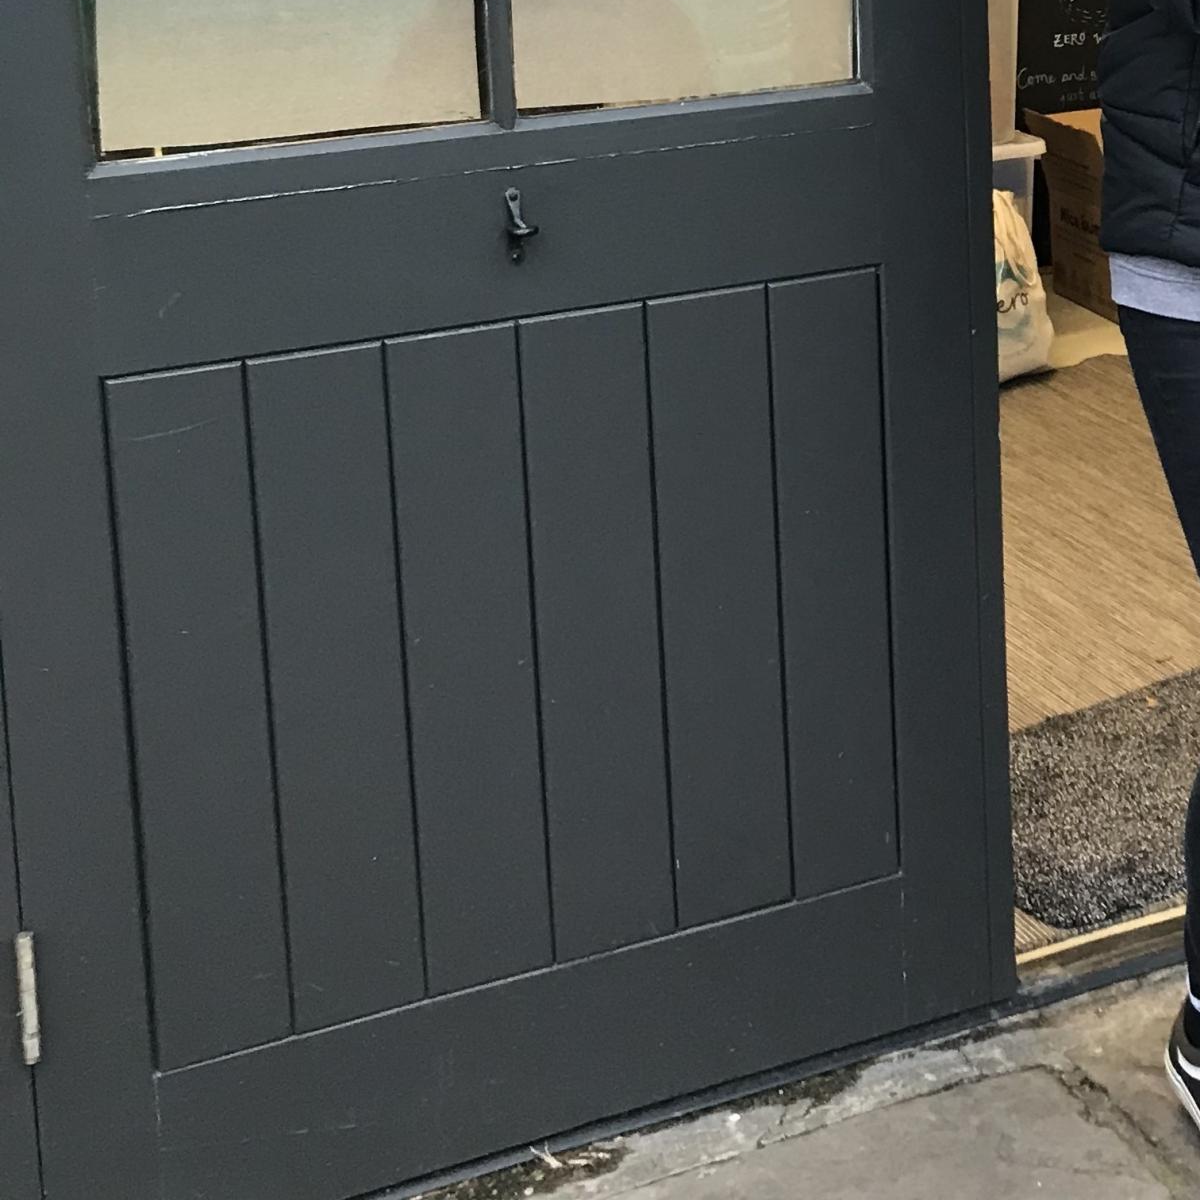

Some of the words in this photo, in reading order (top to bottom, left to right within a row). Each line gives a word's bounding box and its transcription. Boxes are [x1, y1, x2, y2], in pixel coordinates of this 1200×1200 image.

[1053, 32, 1086, 48] ZERO
[1017, 66, 1056, 90] Come
[1061, 64, 1087, 83] and
[996, 292, 1029, 313] ero
